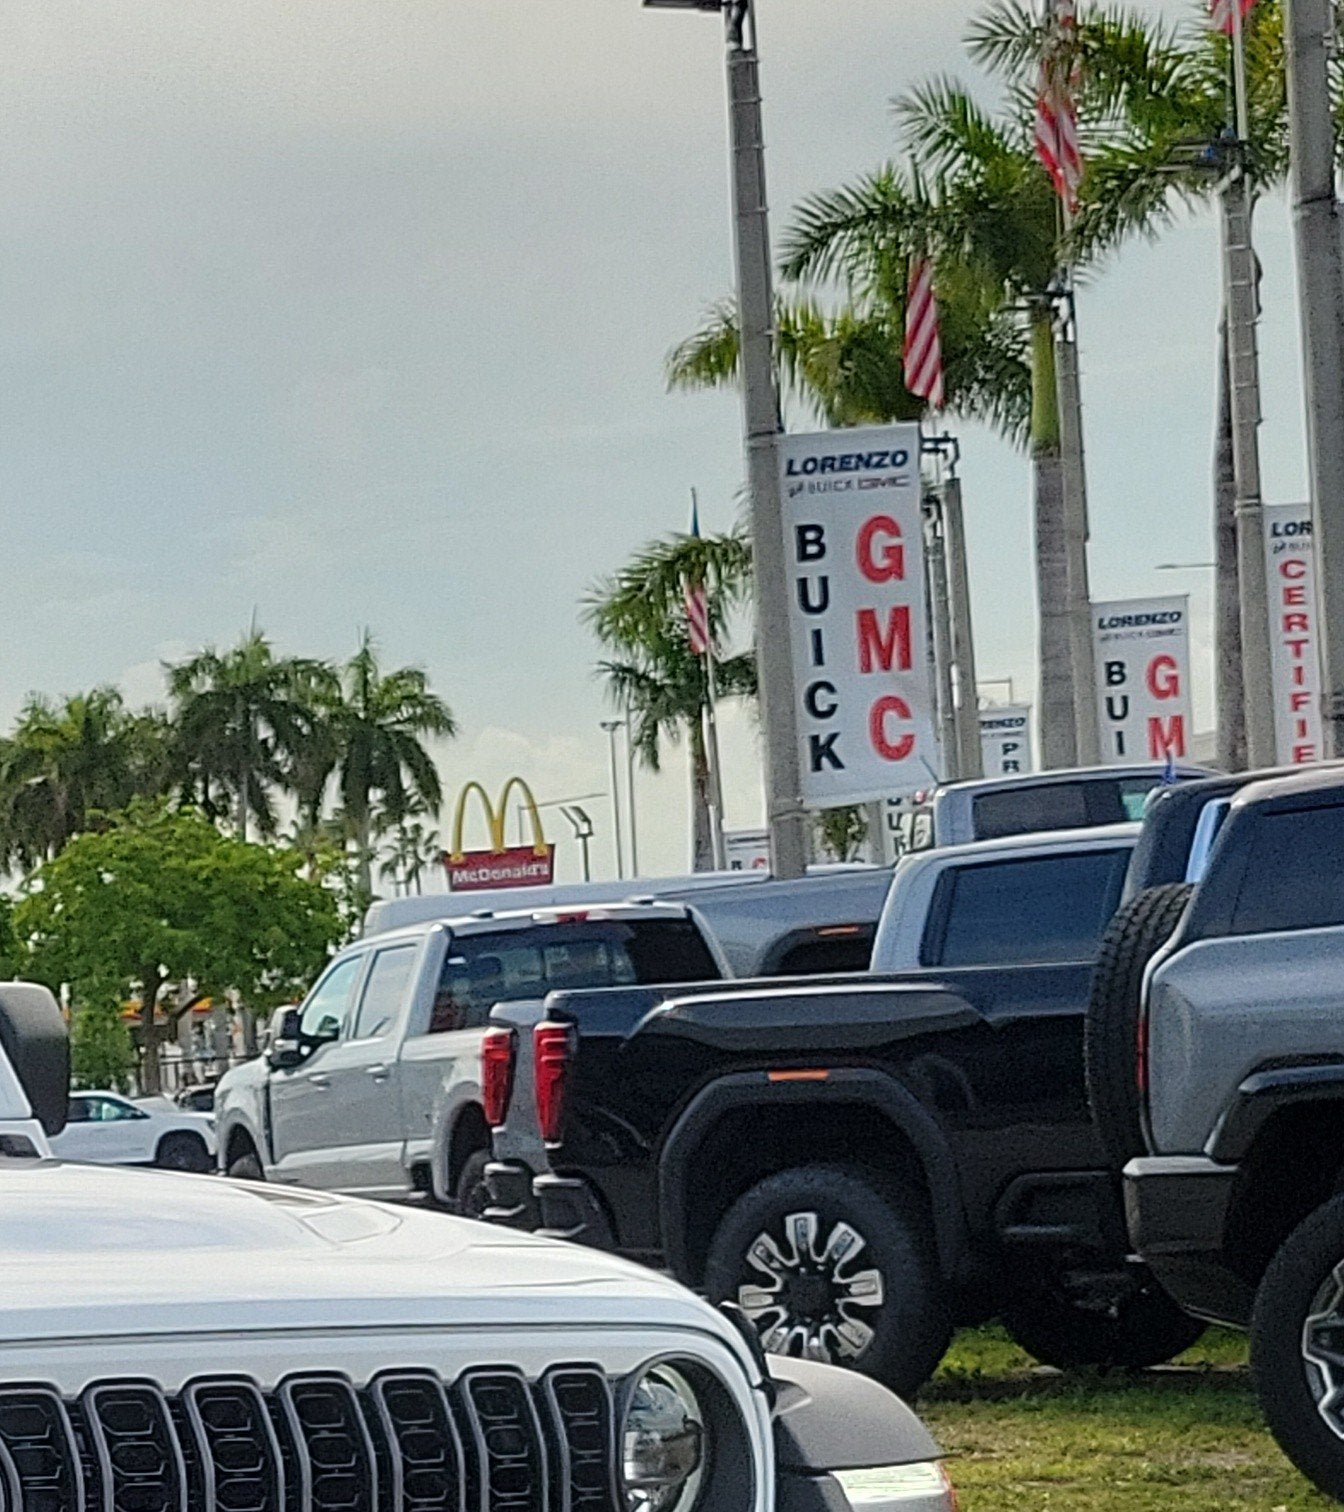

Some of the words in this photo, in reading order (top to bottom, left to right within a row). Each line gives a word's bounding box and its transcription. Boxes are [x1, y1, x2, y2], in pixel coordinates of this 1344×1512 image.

[786, 450, 909, 476] LORENZO
[795, 523, 845, 773] BUICK
[856, 515, 916, 763] GMC
